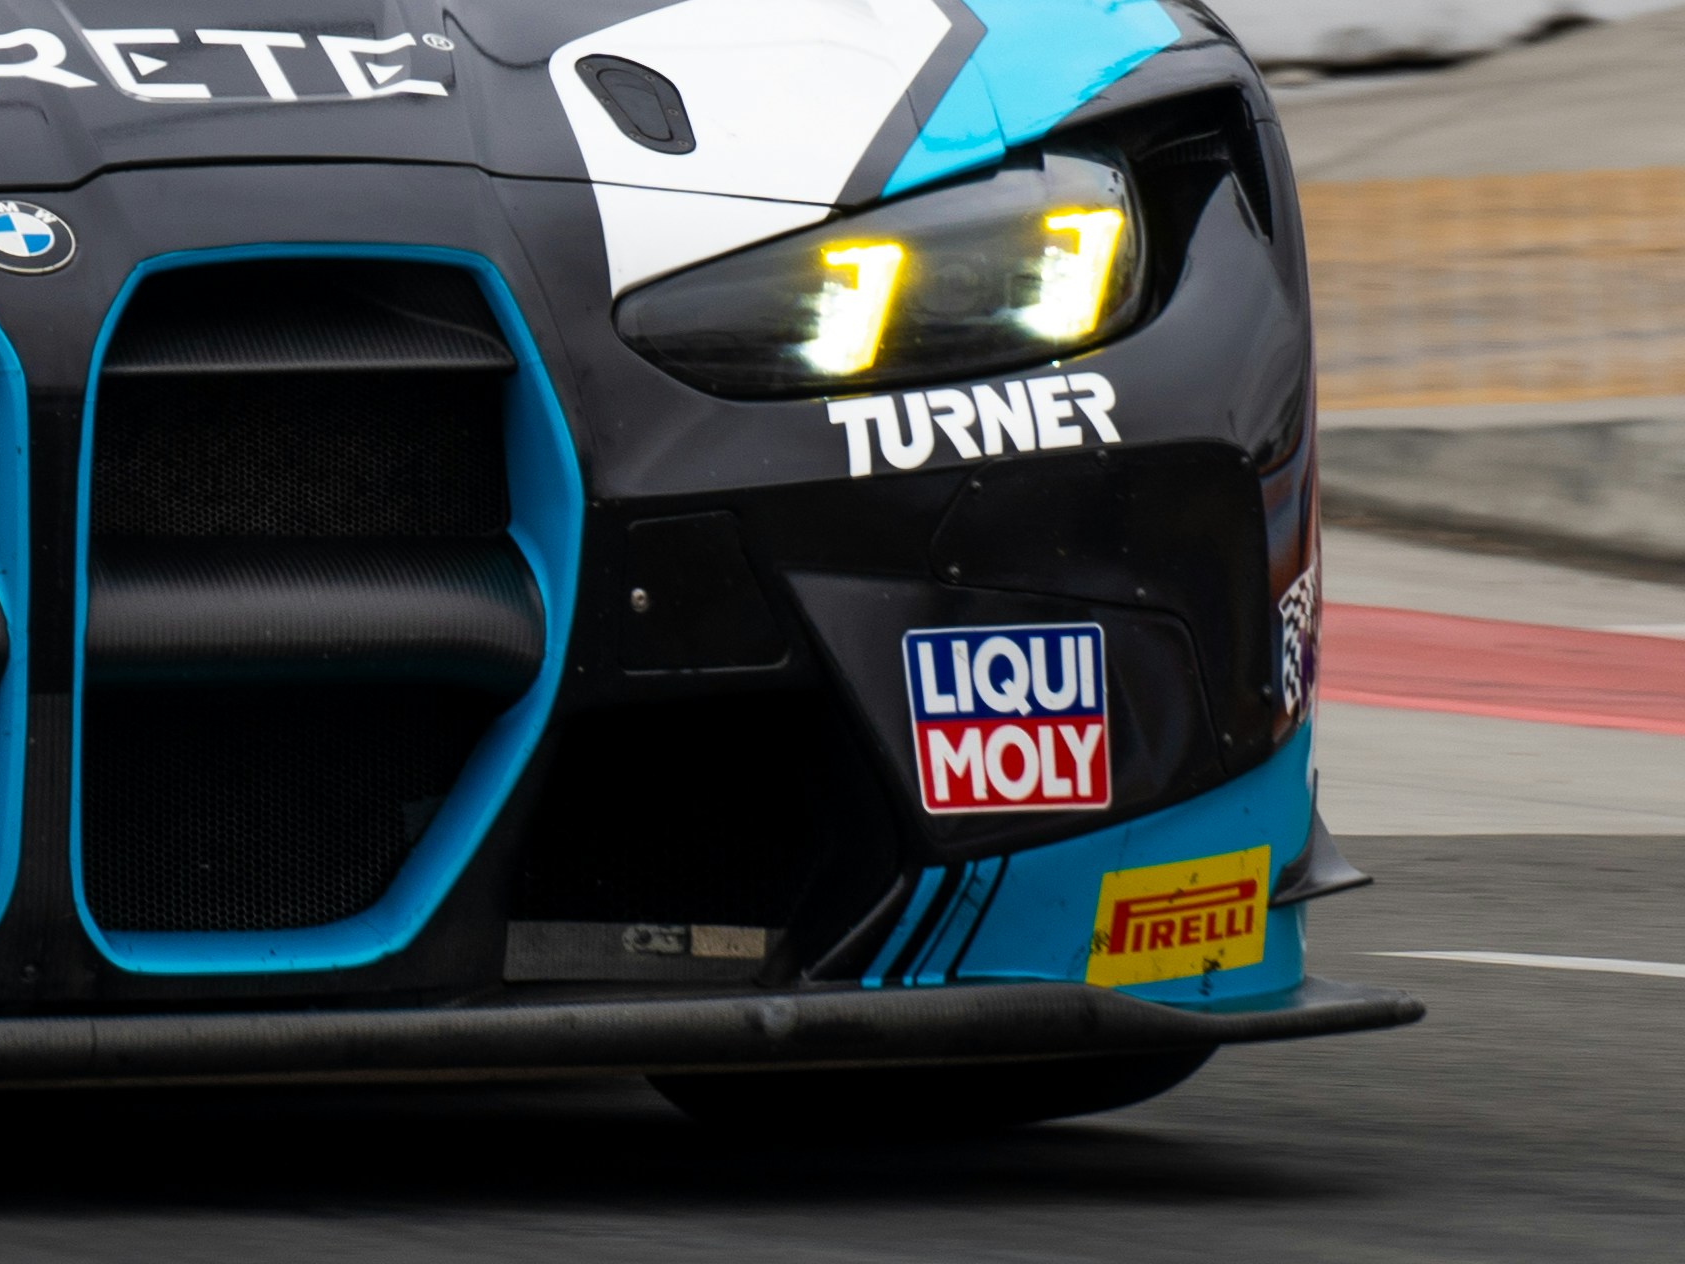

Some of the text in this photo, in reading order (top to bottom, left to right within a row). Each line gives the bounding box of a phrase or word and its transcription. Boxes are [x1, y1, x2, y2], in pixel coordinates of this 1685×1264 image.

[826, 372, 1122, 478] TURNER
[916, 635, 1097, 717] LIQUI
[926, 723, 1113, 802] MOLY
[1106, 878, 1258, 956] PIRELLI
